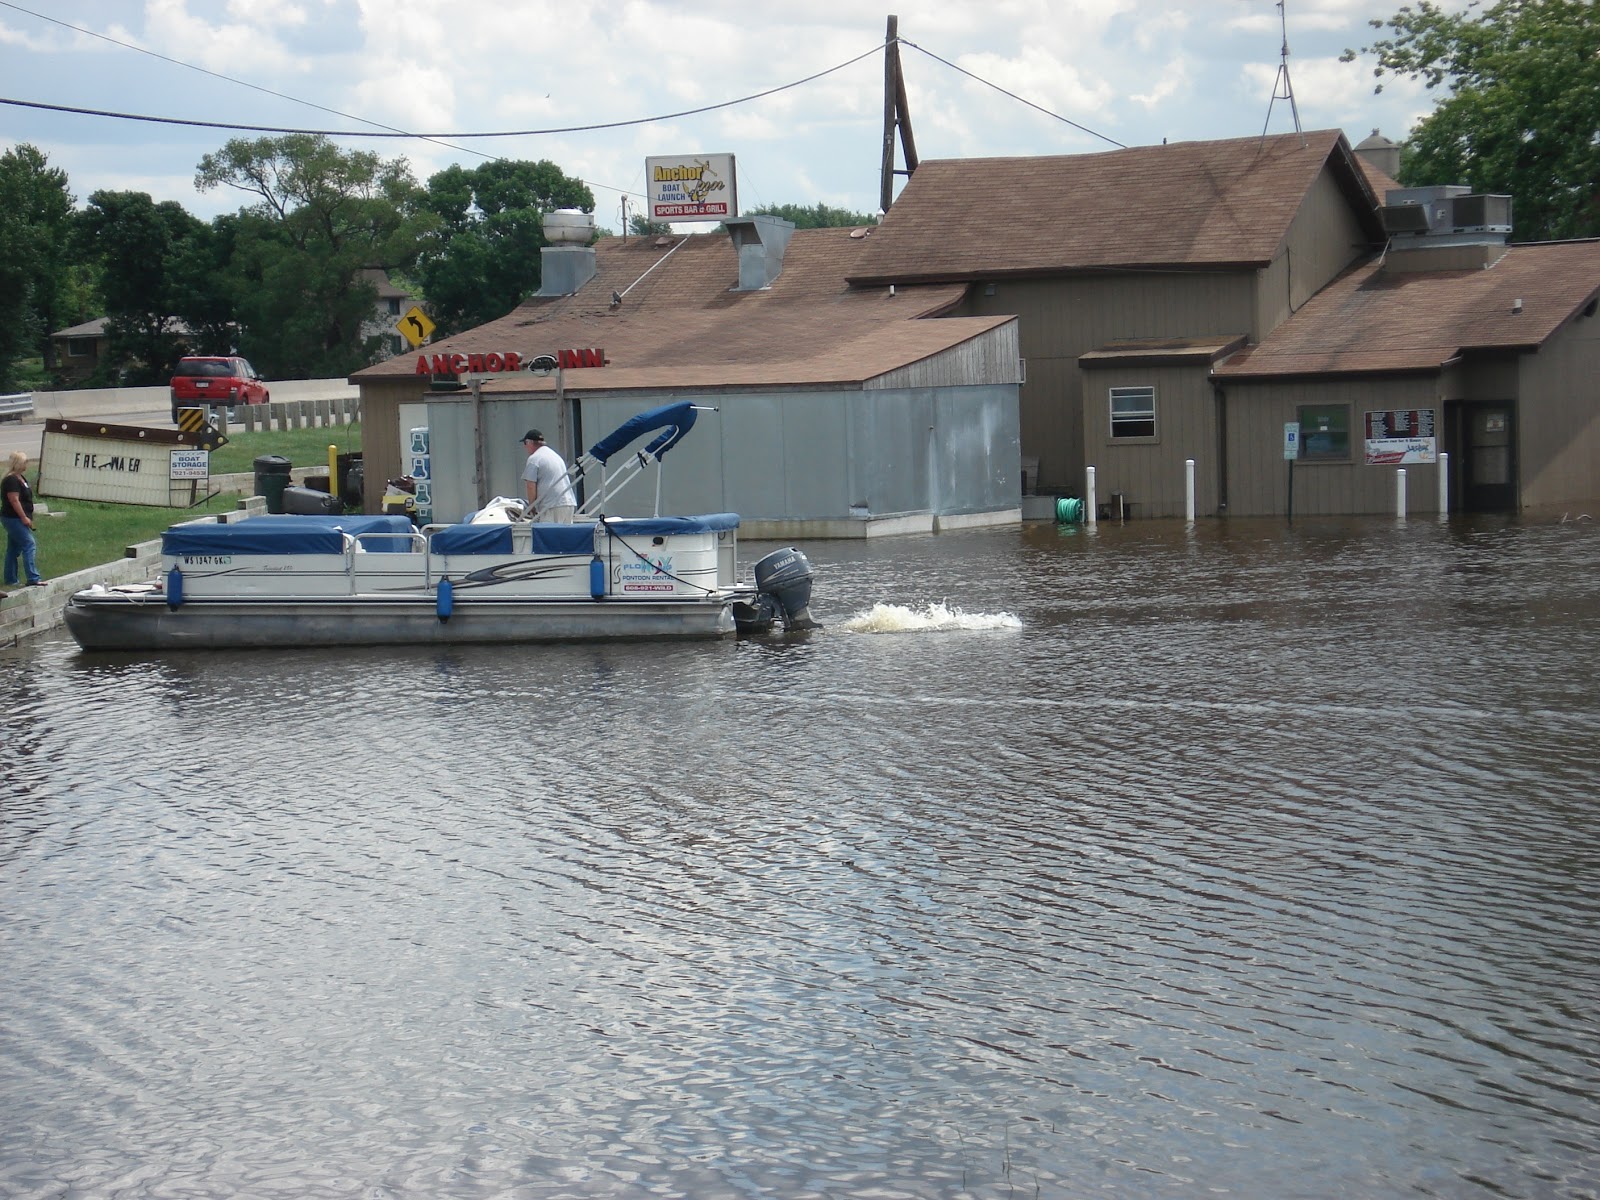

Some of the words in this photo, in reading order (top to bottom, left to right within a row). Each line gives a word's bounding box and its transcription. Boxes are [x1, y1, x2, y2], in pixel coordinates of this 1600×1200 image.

[654, 164, 704, 182] Anchor
[662, 183, 680, 192] BOAT
[657, 192, 686, 202] LAUNCH
[656, 205, 683, 215] SPORTS
[684, 204, 698, 214] BAR
[706, 203, 726, 213] GRILL
[415, 351, 523, 375] ANCHOR
[558, 348, 605, 370] INN
[773, 556, 796, 569] YAMAHA
